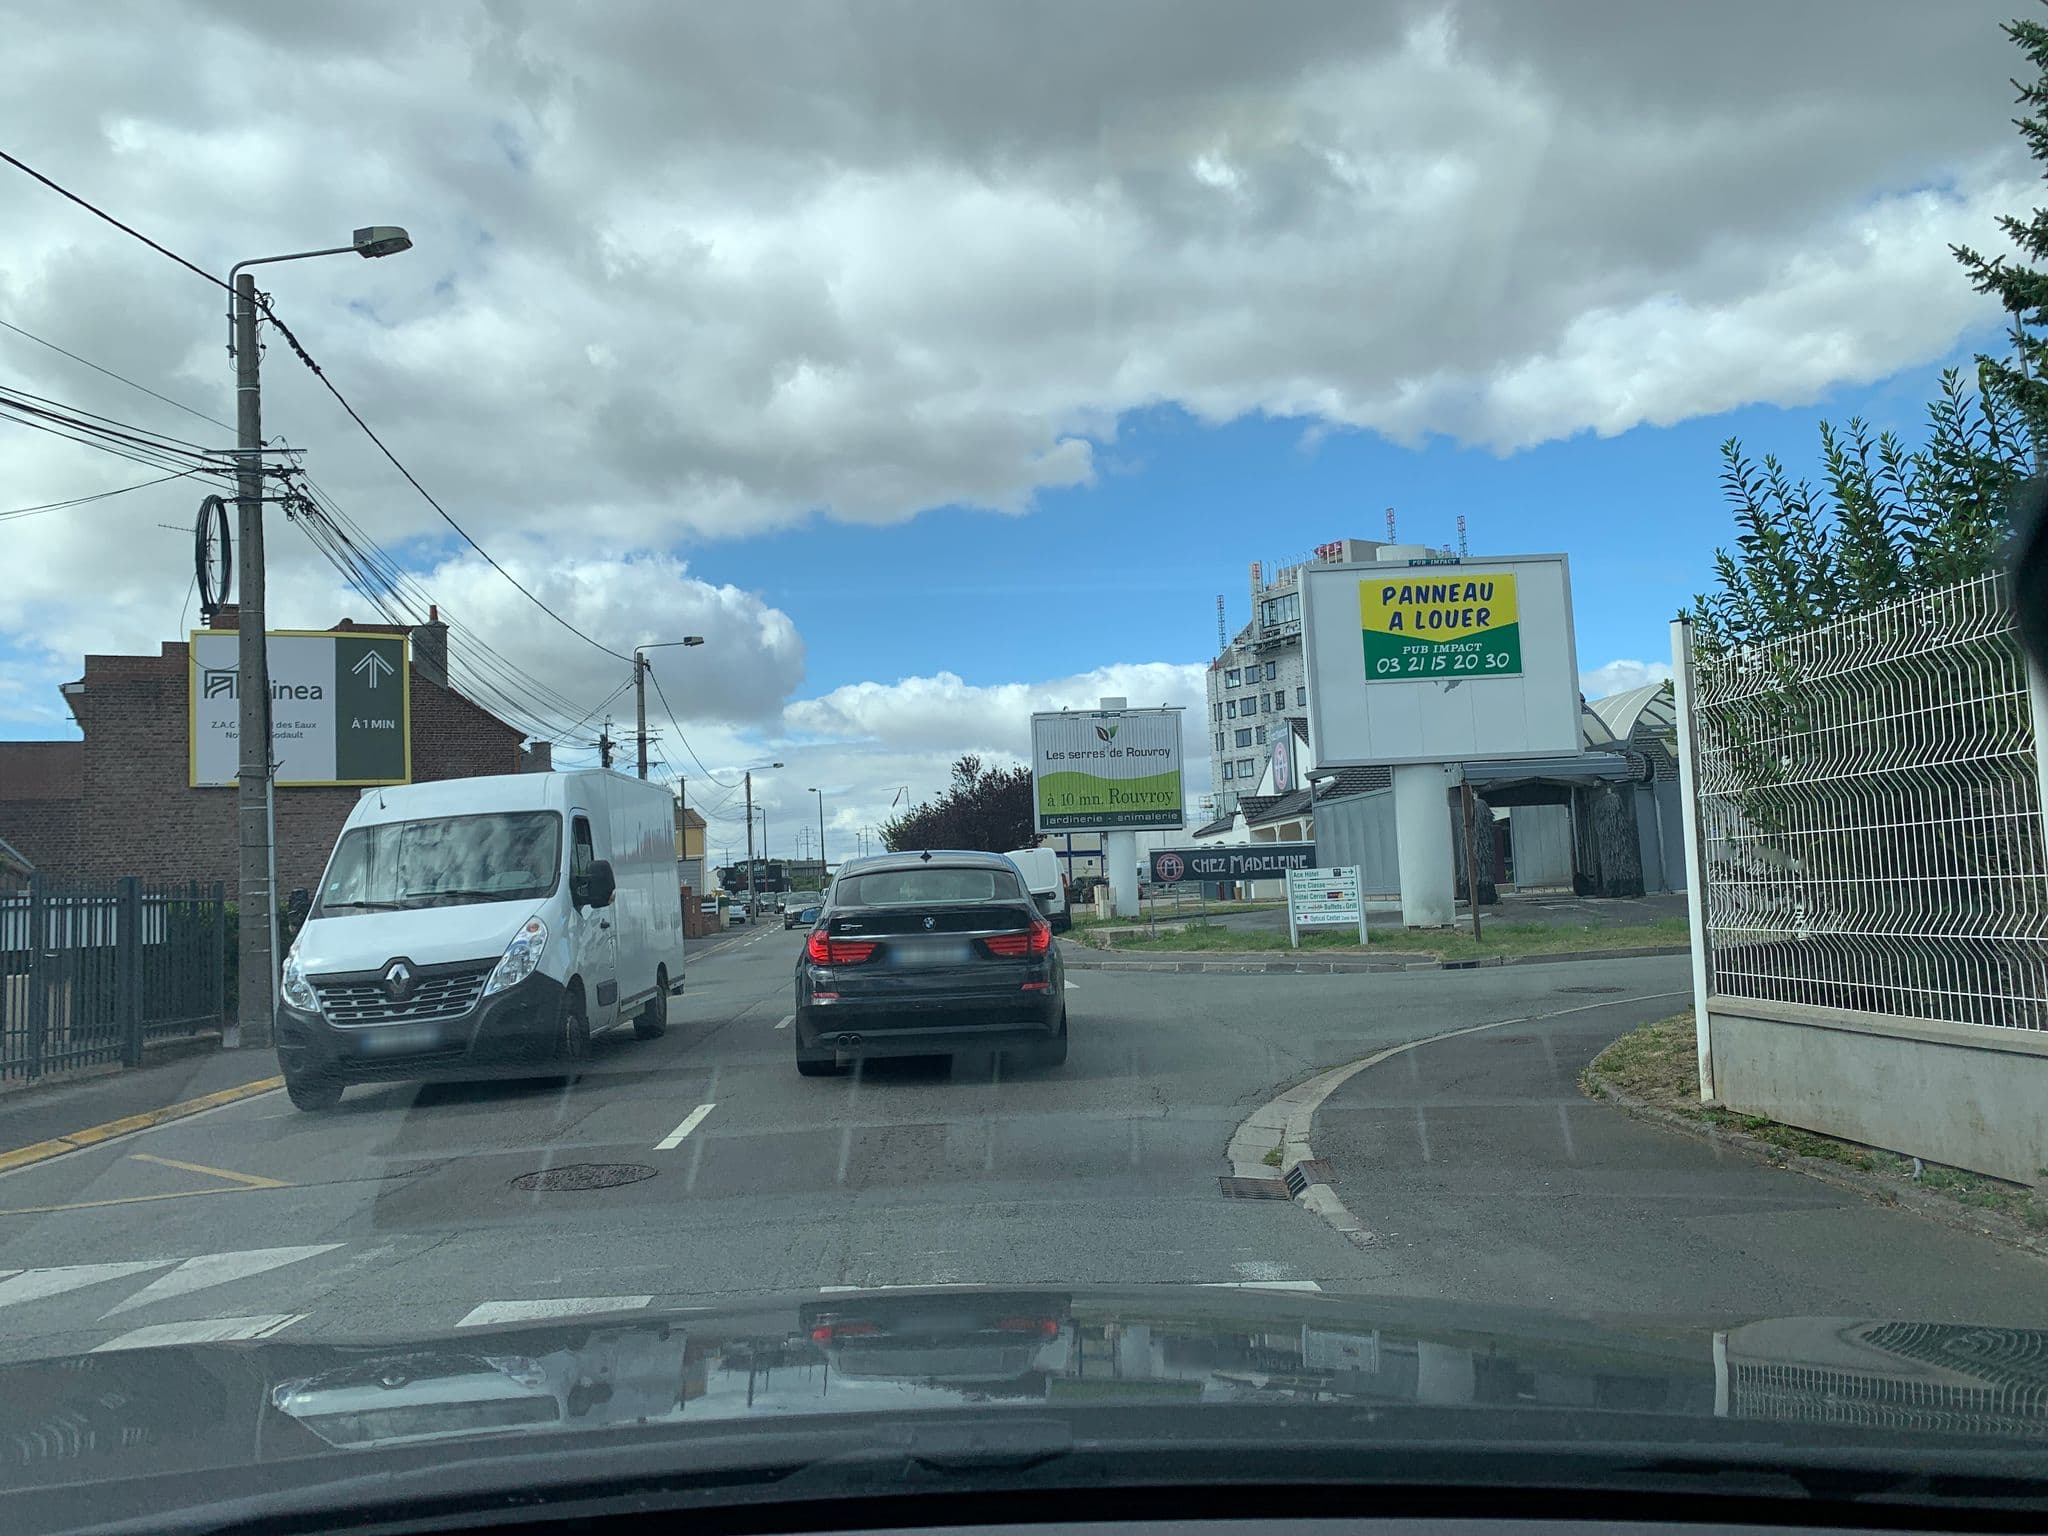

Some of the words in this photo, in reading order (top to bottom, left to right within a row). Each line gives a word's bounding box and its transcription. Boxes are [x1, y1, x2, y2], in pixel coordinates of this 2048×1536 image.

[1430, 558, 1457, 566] IMPACT
[1382, 582, 1494, 606] PANNEAU
[1389, 611, 1403, 631] A
[1415, 607, 1491, 630] LOUER
[1402, 645, 1429, 655] PUB
[1433, 643, 1483, 654] IMPACT
[1377, 657, 1401, 674] 03
[1407, 656, 1425, 672] 21
[1431, 655, 1447, 671] 15
[1453, 654, 1479, 670] 20
[1485, 652, 1510, 668] 30
[276, 721, 292, 729] des
[295, 721, 317, 729] Eaux
[351, 717, 361, 729] À
[362, 719, 368, 729] 1
[371, 719, 395, 729] MIN
[1046, 750, 1065, 760] Les
[1068, 749, 1106, 760] serres
[1109, 747, 1122, 758] de
[1126, 747, 1171, 759] Rouvroy
[1047, 793, 1055, 807] à
[1060, 793, 1074, 807] 10
[1080, 794, 1104, 806] mn.
[1108, 787, 1174, 806] Rouvroy
[1046, 814, 1103, 826] jardinerie
[1117, 812, 1178, 822] animalerie
[1191, 858, 1227, 873] CHEZ
[1230, 854, 1309, 874] MADELEINE
